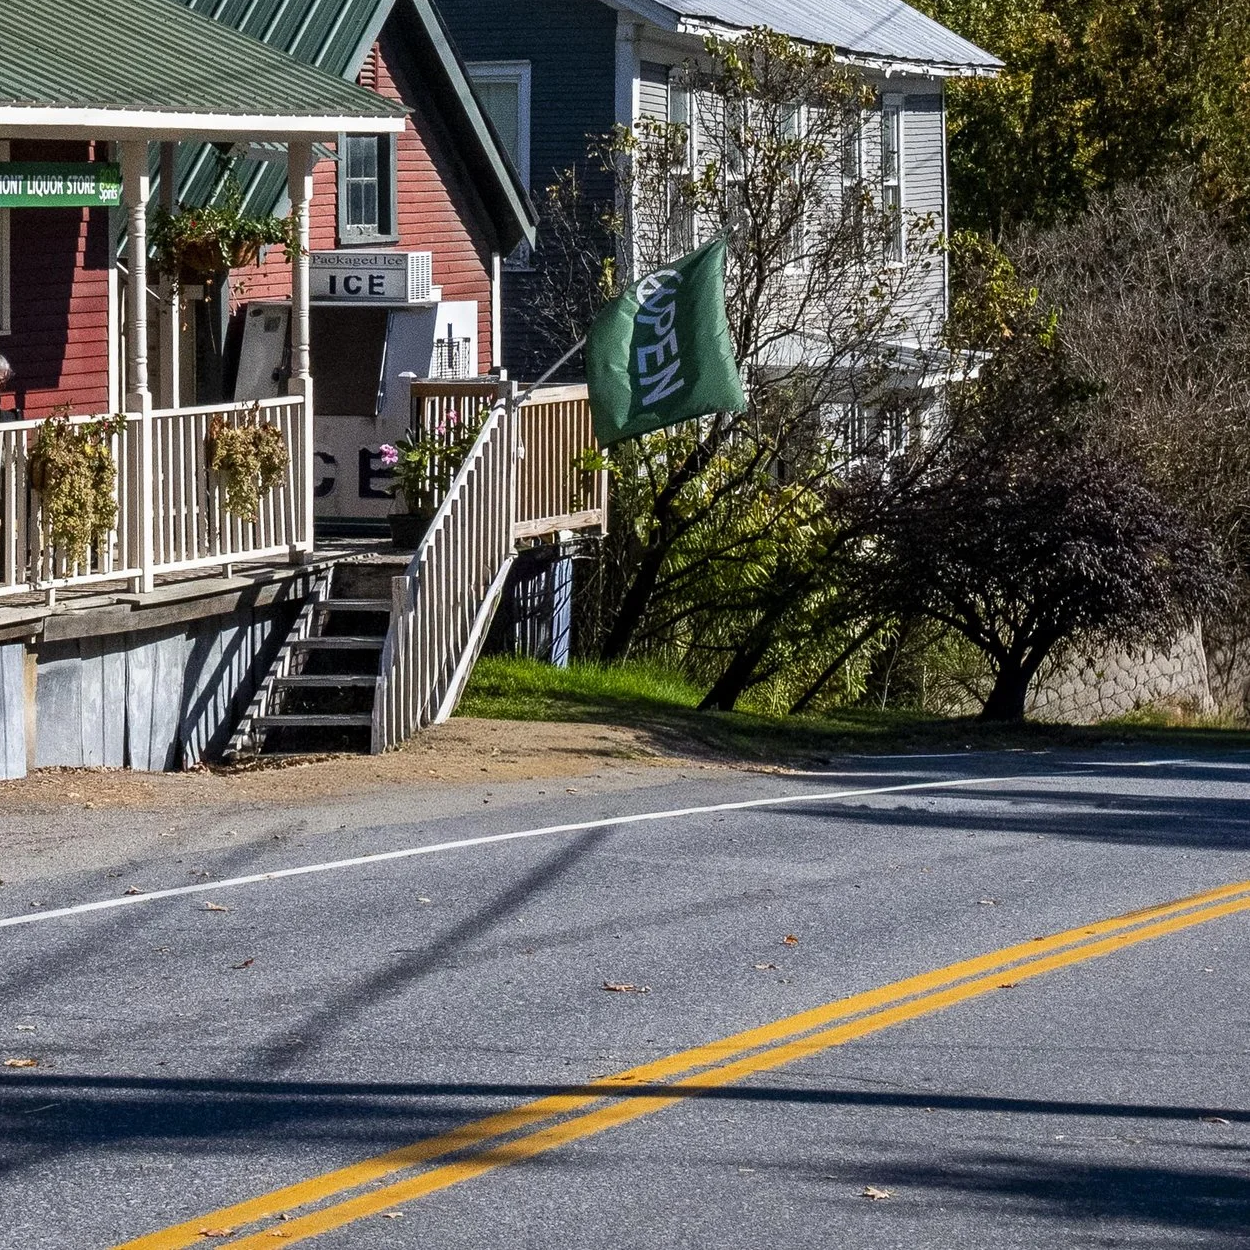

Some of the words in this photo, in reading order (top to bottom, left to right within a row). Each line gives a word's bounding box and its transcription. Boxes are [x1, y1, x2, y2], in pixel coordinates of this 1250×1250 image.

[26, 174, 64, 197] LIQUOR
[66, 174, 96, 195] STORE
[312, 254, 378, 266] Packaged
[383, 256, 403, 265] Ice
[329, 274, 386, 296] ICE
[635, 269, 685, 406] OPEN
